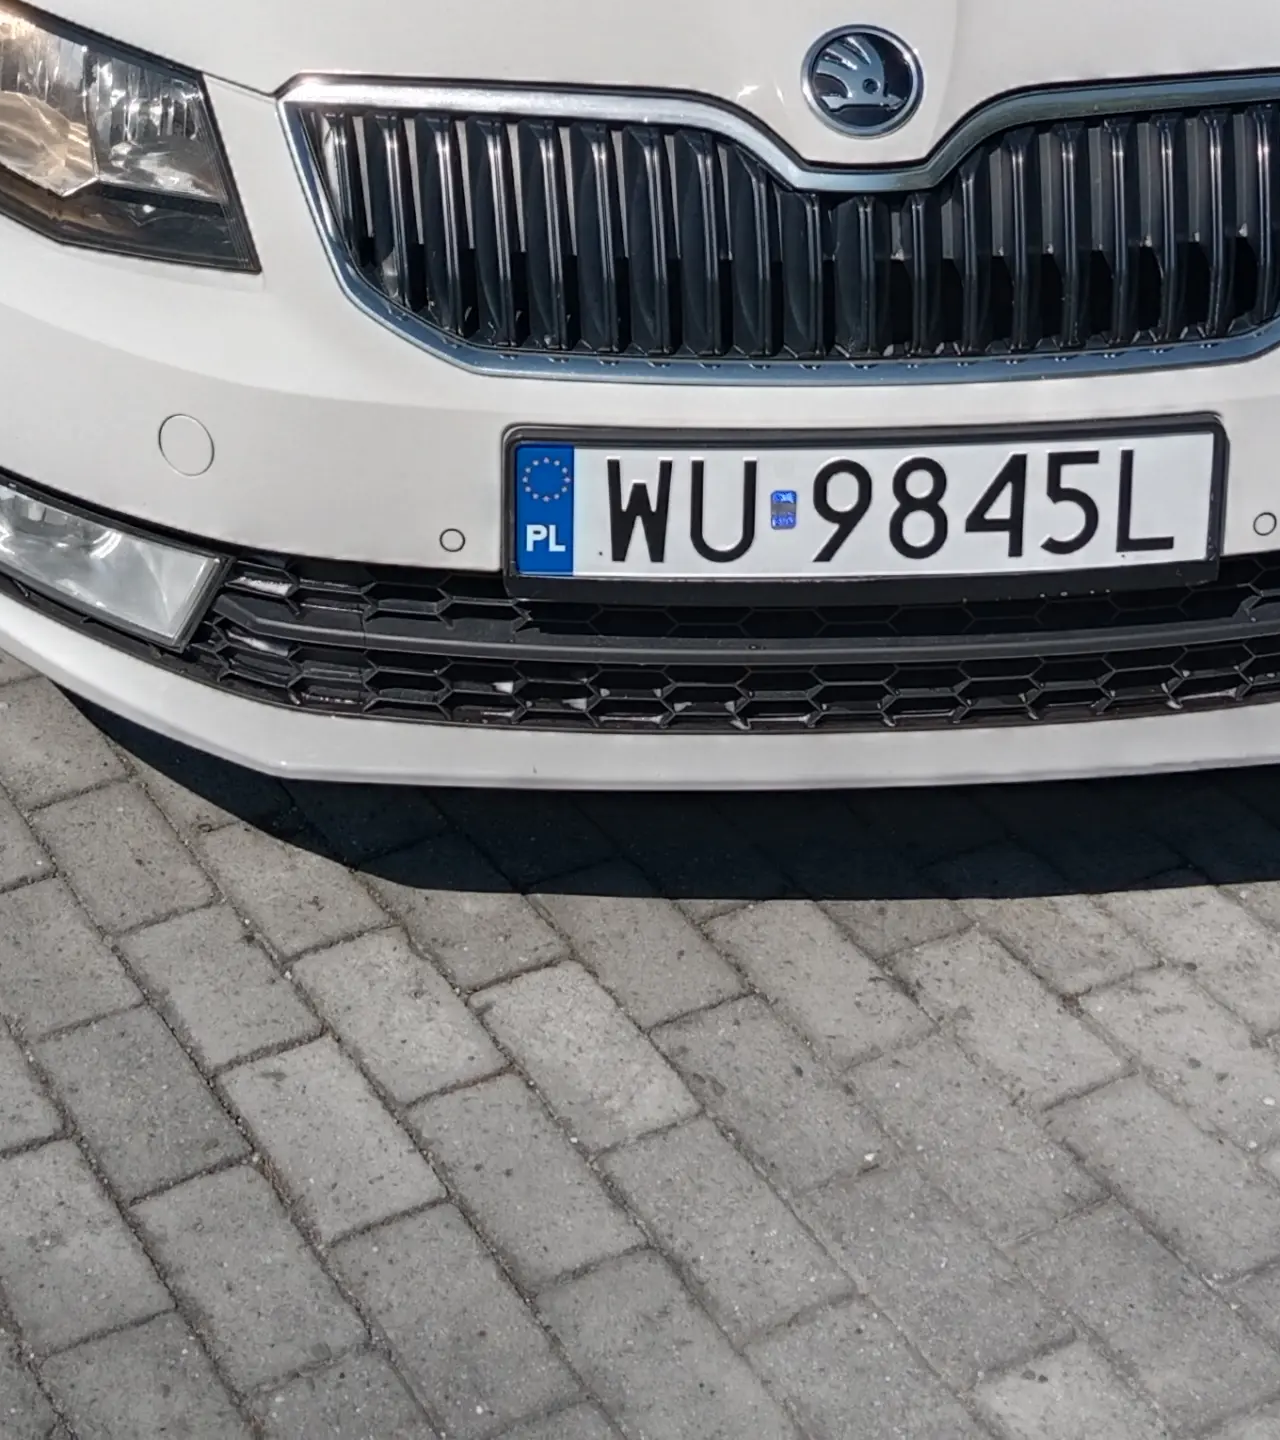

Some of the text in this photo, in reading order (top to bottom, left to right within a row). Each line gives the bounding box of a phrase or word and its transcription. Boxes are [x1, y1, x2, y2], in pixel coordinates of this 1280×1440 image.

[526, 524, 566, 553] PL
[606, 449, 1175, 562] WU 9845L
